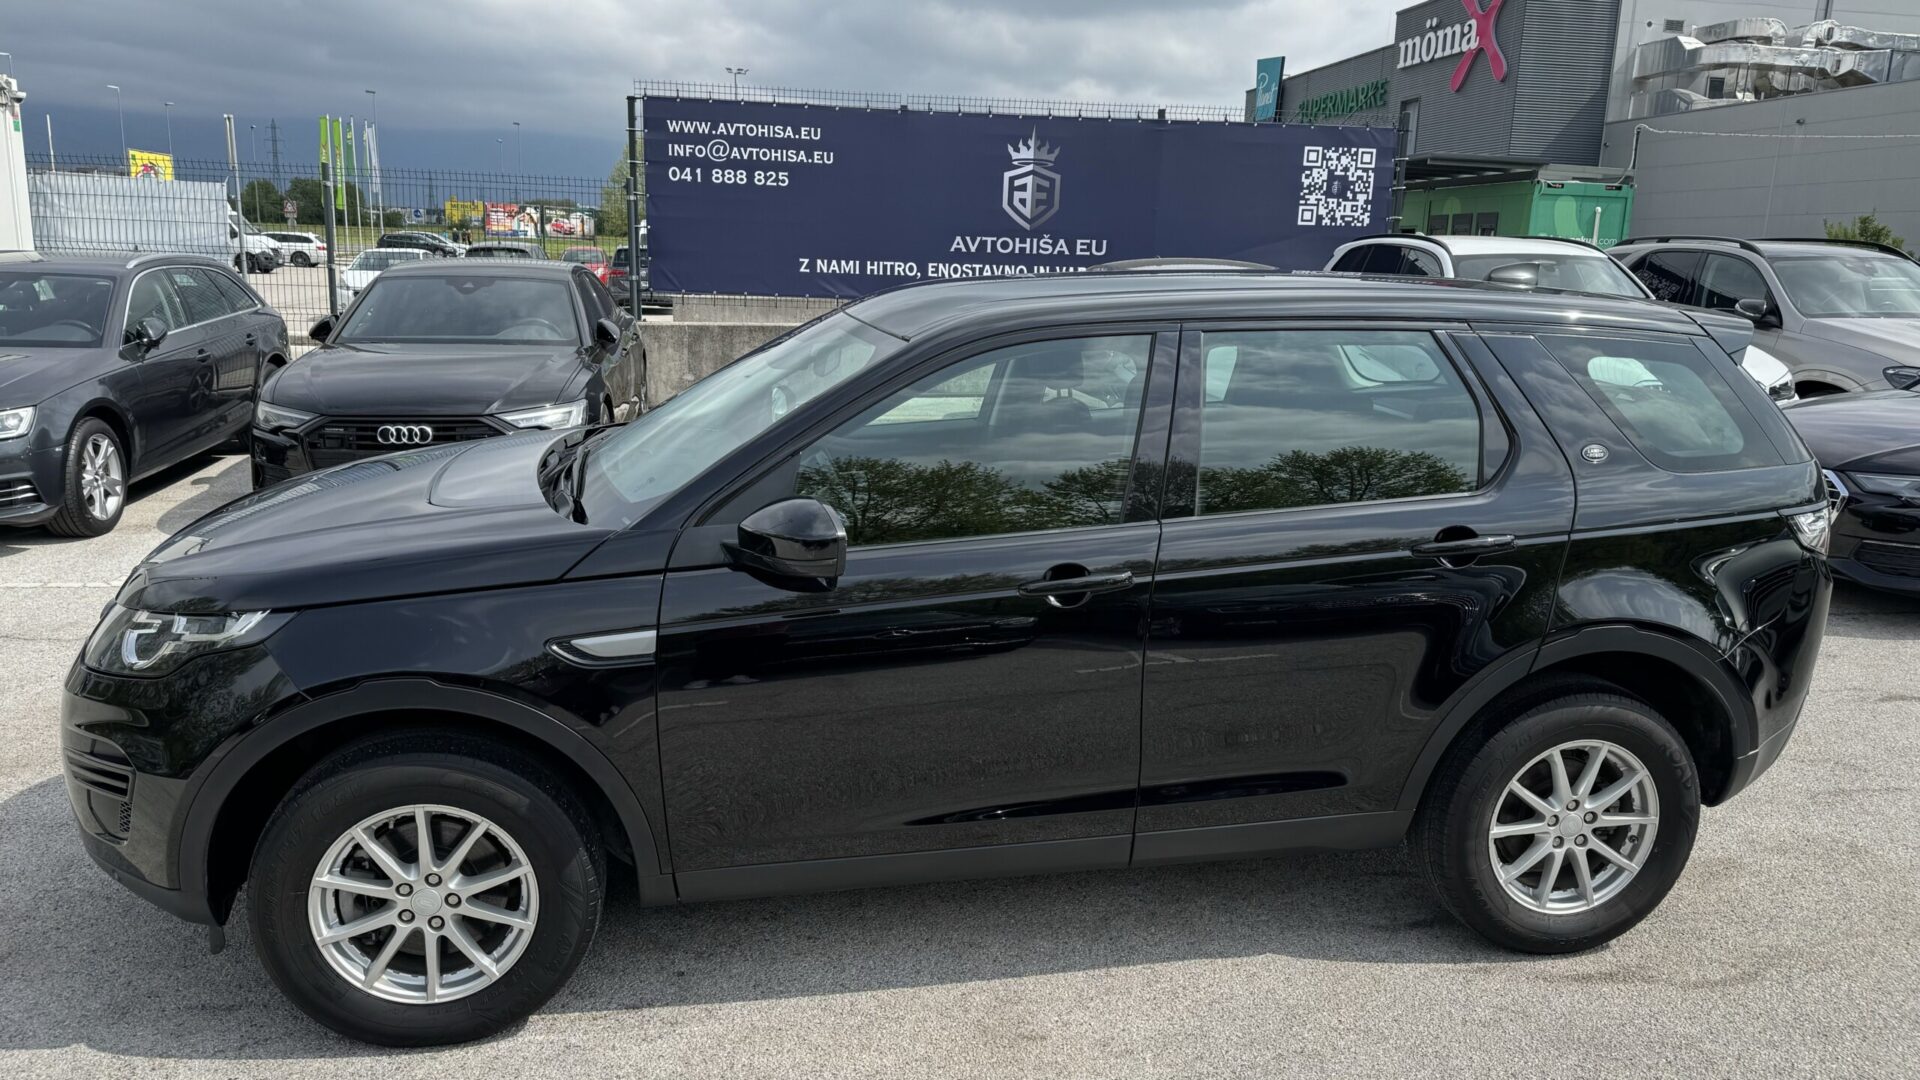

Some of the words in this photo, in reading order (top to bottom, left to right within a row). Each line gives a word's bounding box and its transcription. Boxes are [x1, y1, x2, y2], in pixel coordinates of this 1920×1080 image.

[667, 119, 821, 141] WWW.AVTOHISA.EU
[668, 139, 834, 164] INFO@AVTOHISA.EU
[668, 167, 702, 183] 041
[711, 168, 748, 185] 888
[753, 170, 789, 187] 825
[950, 234, 1070, 255] AVTOHIŠA
[1075, 239, 1107, 256] EU
[799, 258, 810, 273] Z
[816, 259, 860, 275] NAMI
[866, 261, 921, 280] HITRO,
